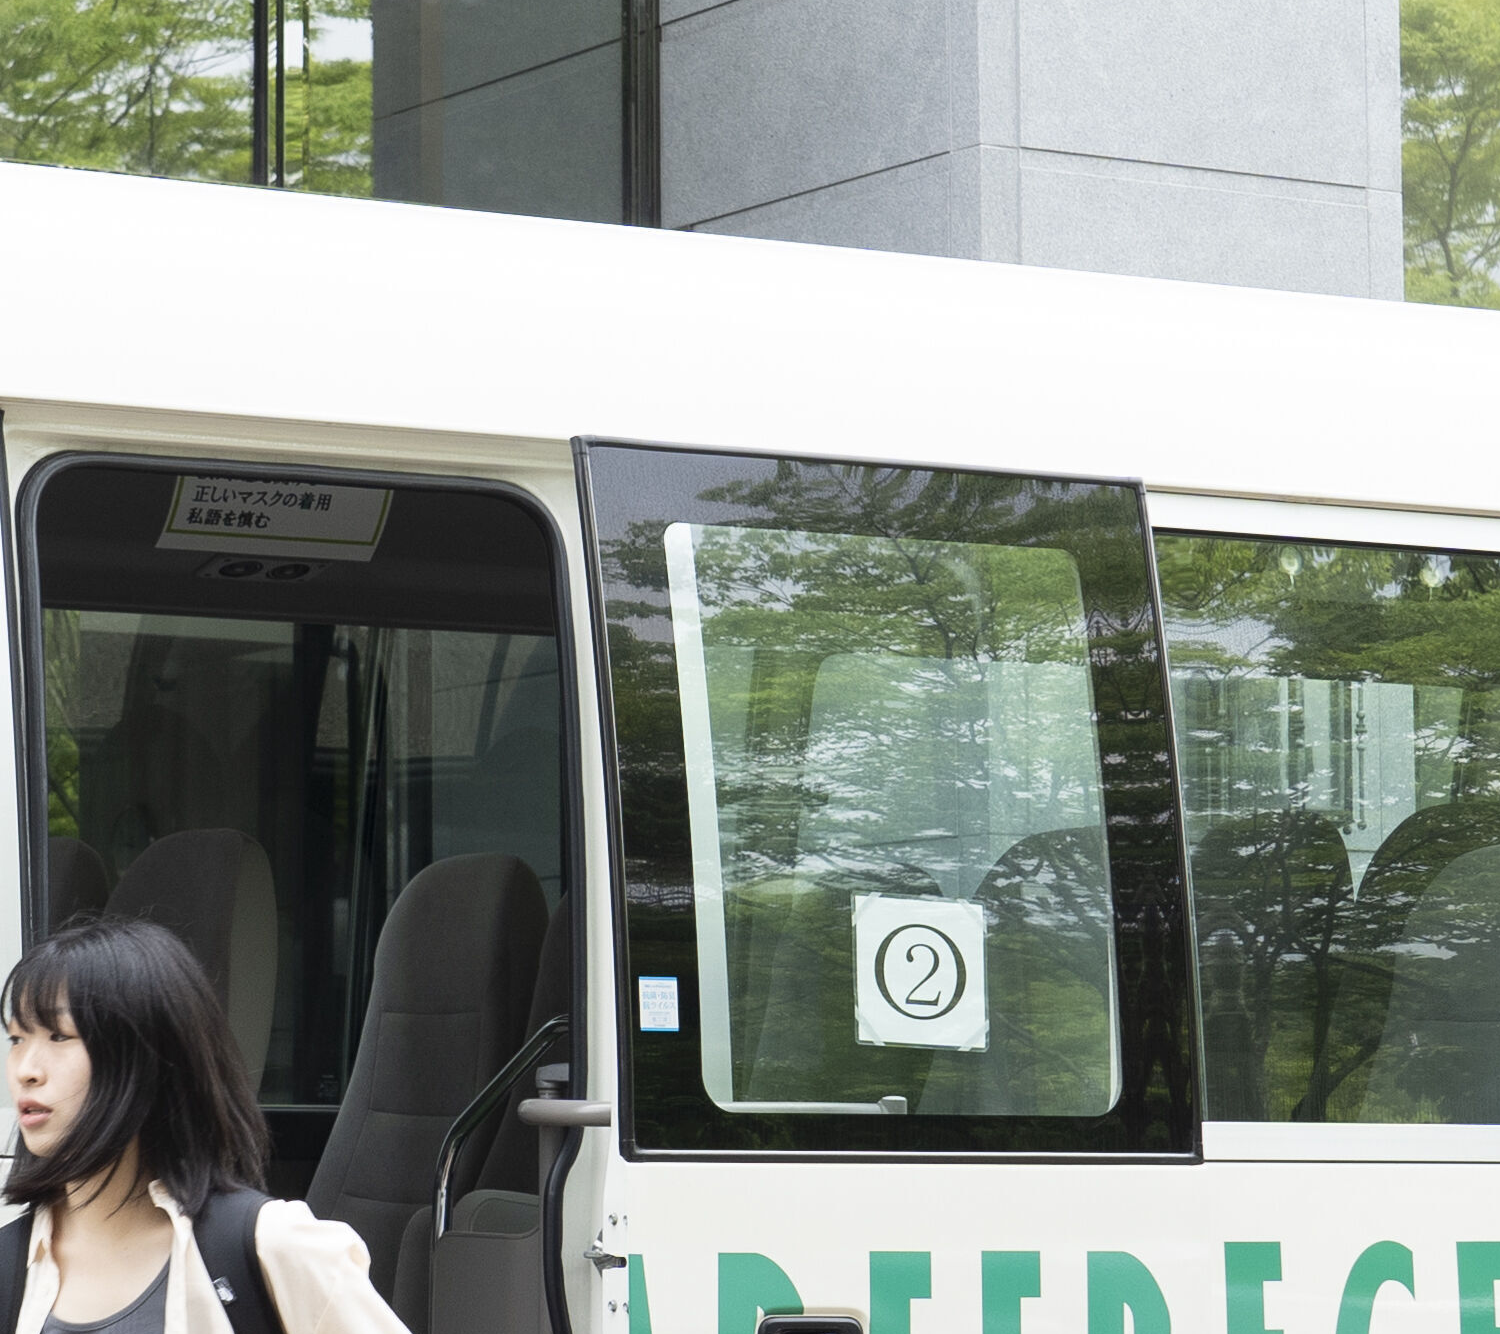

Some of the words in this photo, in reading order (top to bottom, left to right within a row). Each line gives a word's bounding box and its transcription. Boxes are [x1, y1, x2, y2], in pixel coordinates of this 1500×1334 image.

[192, 484, 333, 512] 正しいマスクの着用
[186, 507, 271, 529] 私語を慎む
